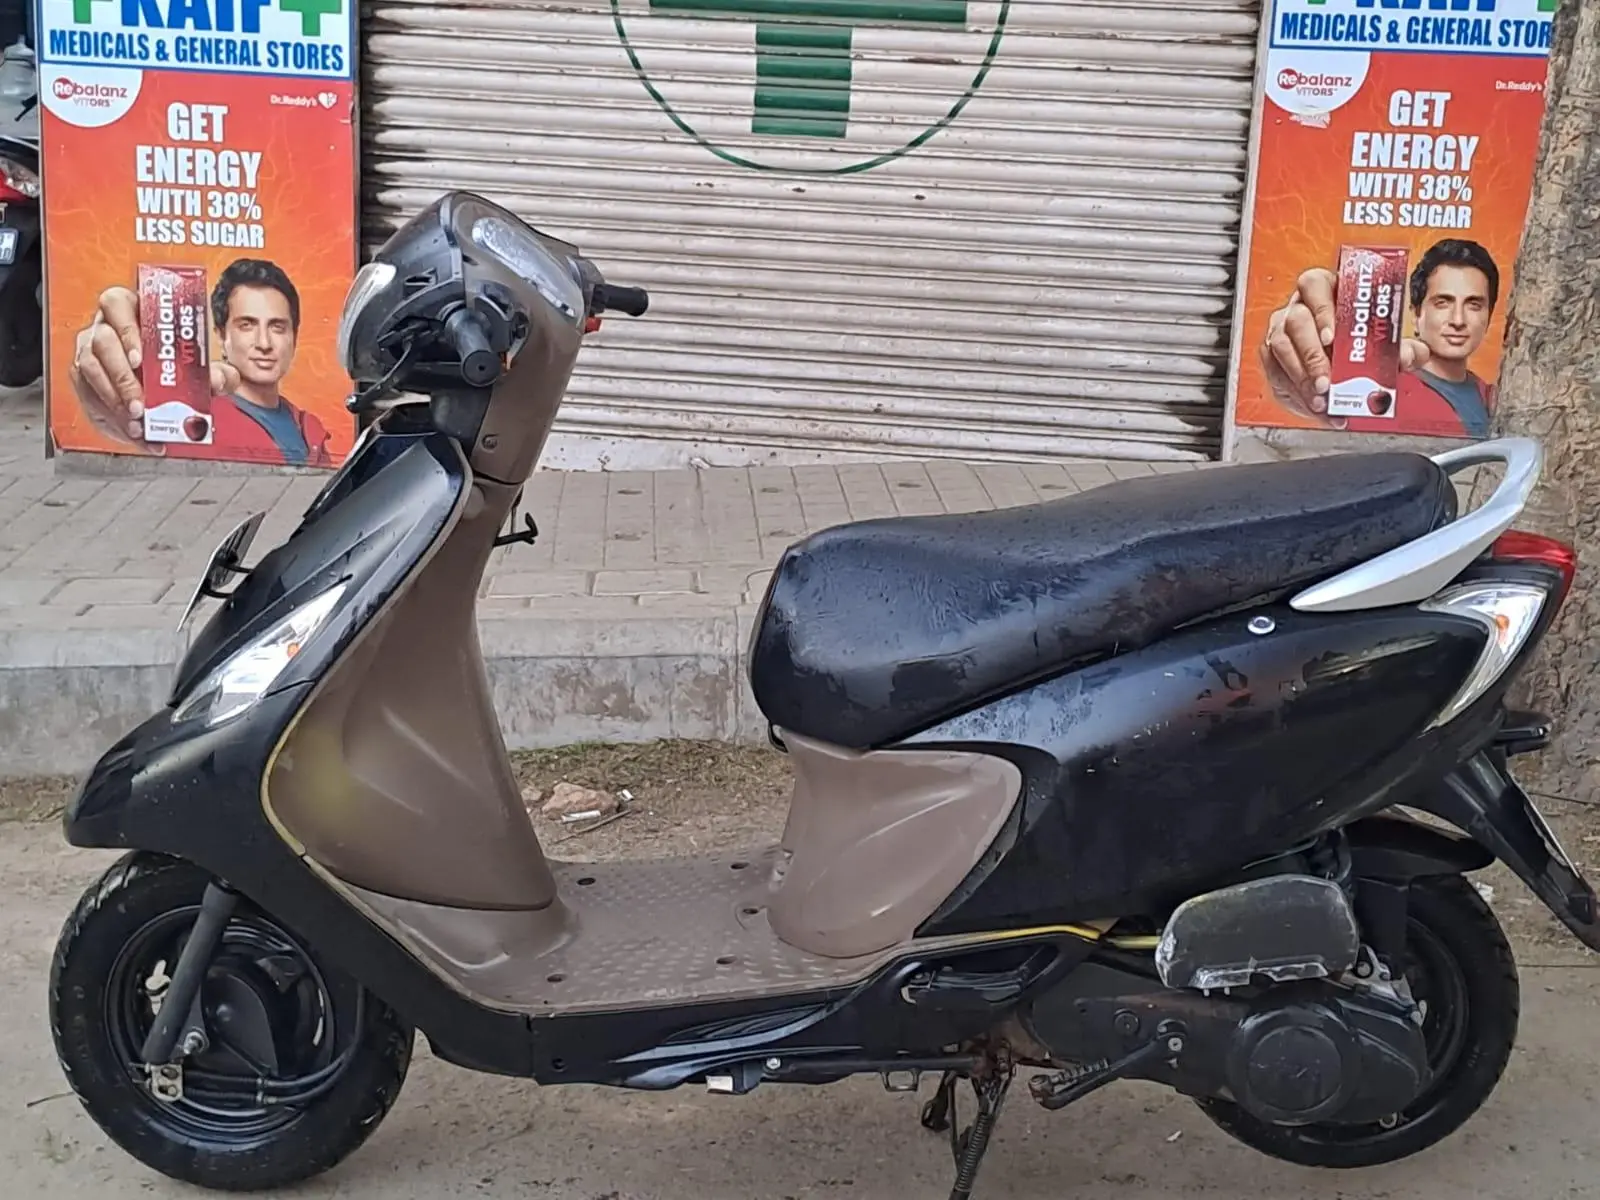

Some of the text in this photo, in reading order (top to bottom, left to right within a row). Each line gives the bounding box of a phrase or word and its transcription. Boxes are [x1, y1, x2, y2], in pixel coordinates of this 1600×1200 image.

[1280, 12, 1382, 43] MEDICALS
[1386, 19, 1400, 43] &
[1406, 16, 1491, 46] GENERAL
[49, 29, 344, 71] MEDICALS & GENERAL STORES
[53, 78, 128, 99] Rebalanz
[1277, 68, 1353, 89] Rebalanz
[167, 102, 229, 142] GET
[1388, 89, 1451, 128] GET
[136, 145, 262, 188] ENERGY
[1351, 132, 1479, 171] ENERGY
[137, 187, 262, 221] WITH 38%
[1349, 172, 1473, 202] WITH 38%
[135, 217, 265, 249] LESS SUGAR
[1343, 201, 1471, 229] LESS SUGAR
[1349, 263, 1373, 362] Rebalanz
[157, 283, 176, 387] Rebalanz
